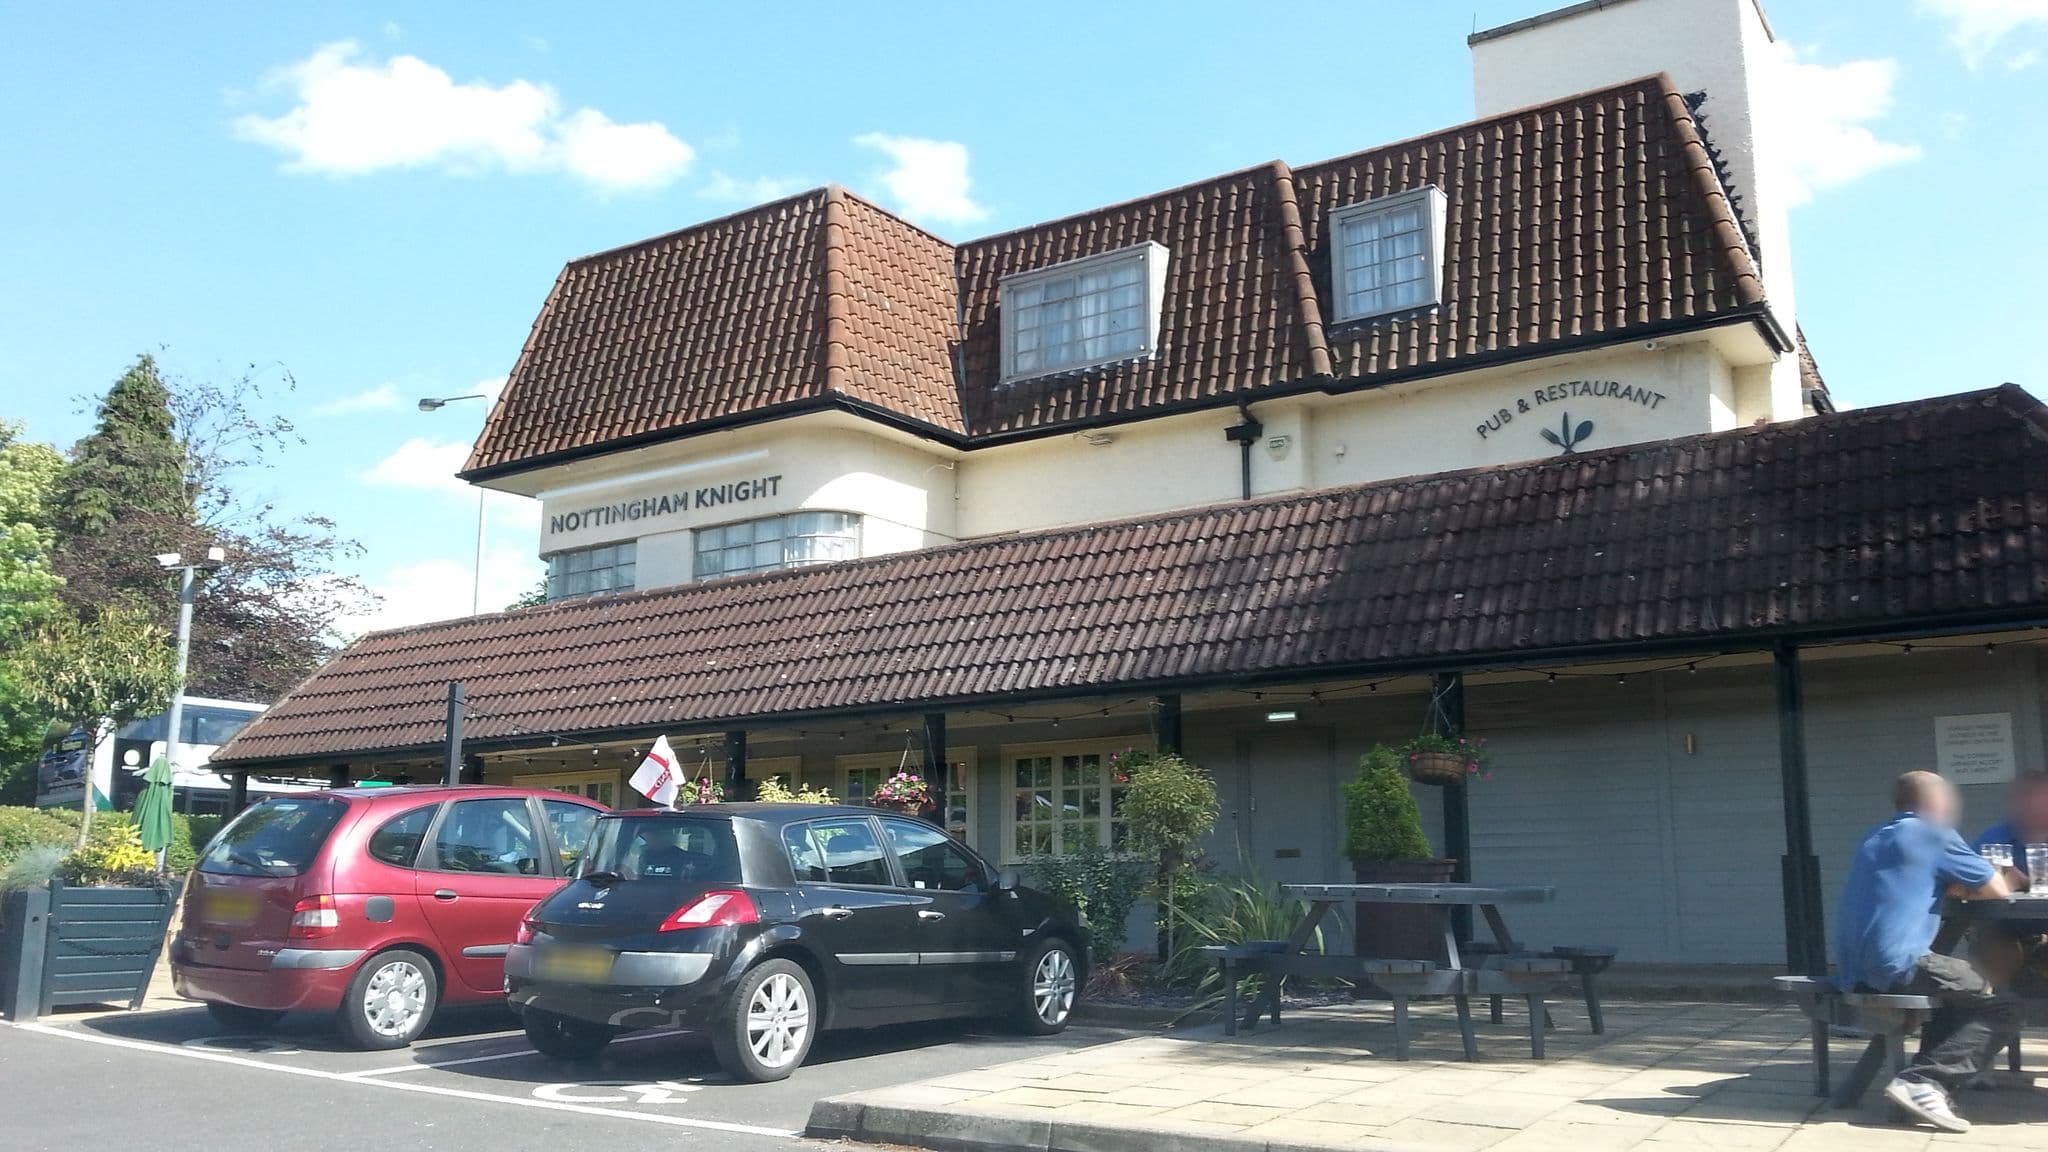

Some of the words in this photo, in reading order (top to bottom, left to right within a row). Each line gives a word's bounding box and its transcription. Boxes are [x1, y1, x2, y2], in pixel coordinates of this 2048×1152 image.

[1476, 408, 1513, 440] PUB
[1516, 398, 1531, 414] &
[1534, 380, 1667, 410] RESTAURANT
[550, 492, 689, 535] NOTTINGHAM
[695, 475, 783, 510] KNIGHT
